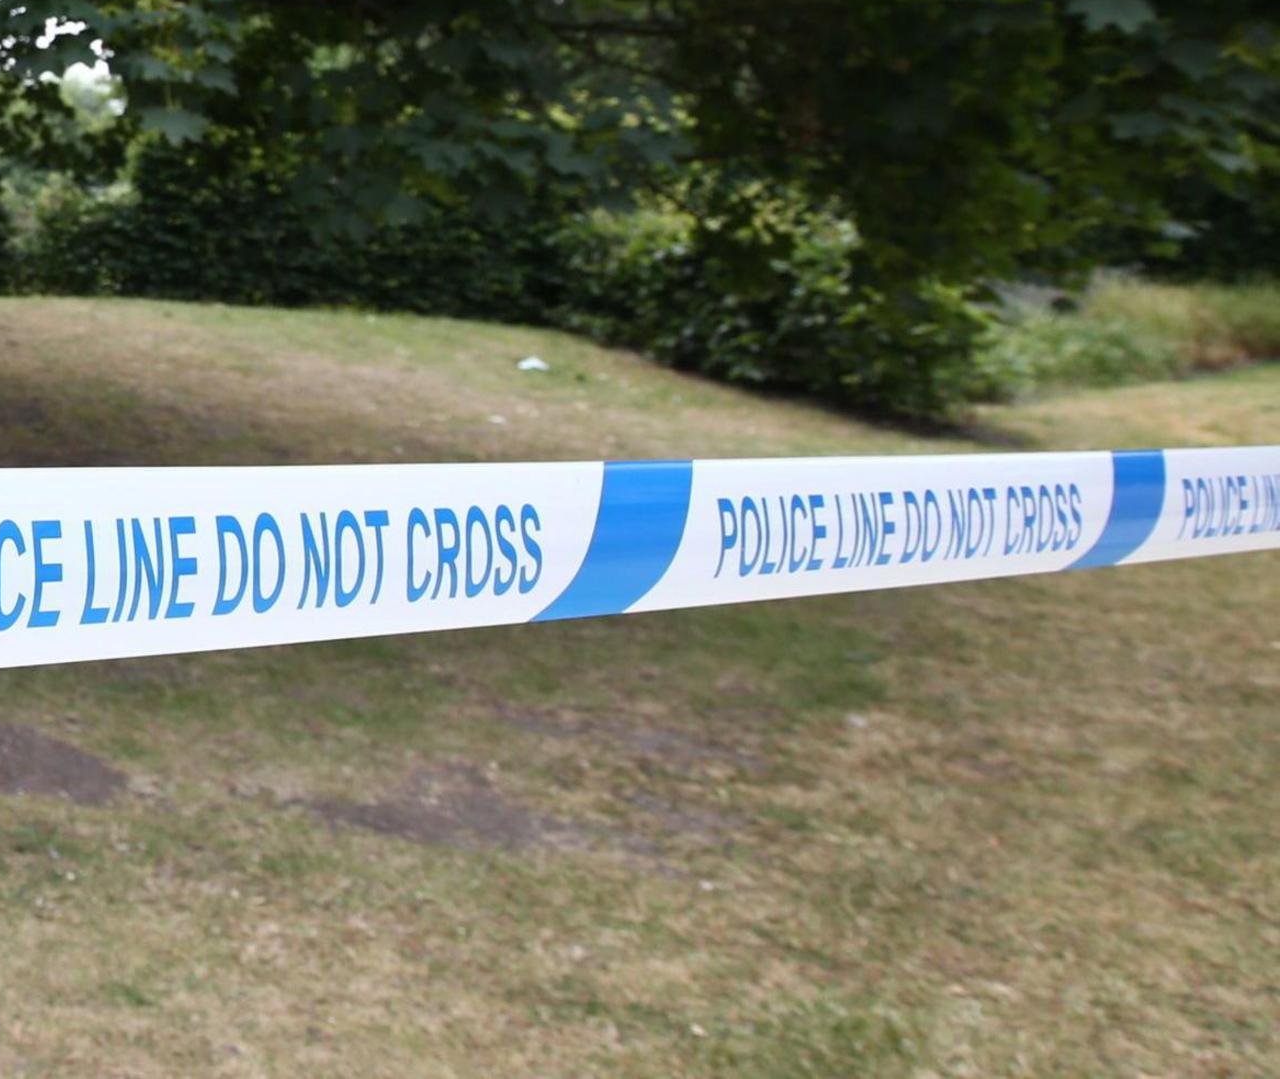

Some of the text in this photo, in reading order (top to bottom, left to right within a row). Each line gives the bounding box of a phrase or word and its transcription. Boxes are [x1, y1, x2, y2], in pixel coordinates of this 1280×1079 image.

[714, 483, 1083, 579] POLICE LINE DO NOT CROSS
[1177, 475, 1249, 540] POLICE
[80, 515, 198, 626] LINE
[213, 511, 286, 617] DO
[299, 508, 391, 609] NOT
[406, 502, 543, 602] CROSS
